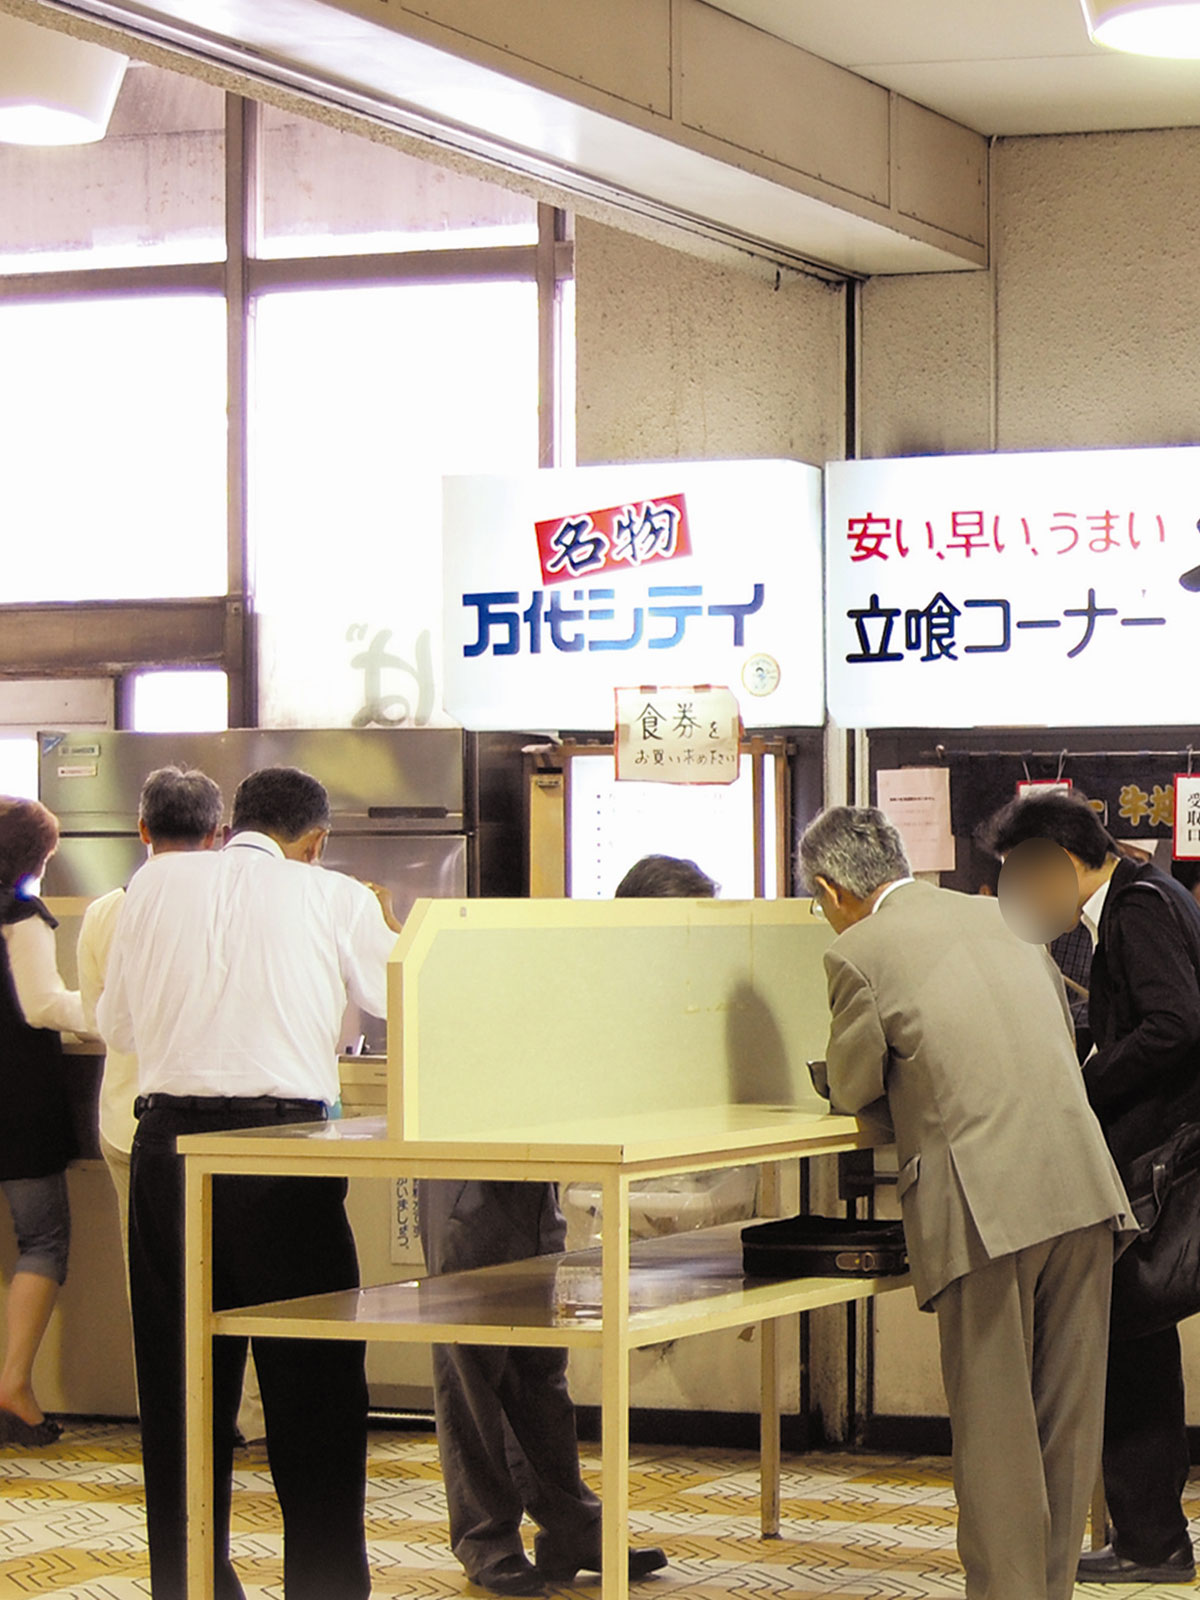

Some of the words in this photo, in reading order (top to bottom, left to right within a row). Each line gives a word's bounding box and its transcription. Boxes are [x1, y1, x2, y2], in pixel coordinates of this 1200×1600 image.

[546, 500, 681, 577] 名物
[846, 588, 1166, 663] 立喰コーナー
[636, 702, 721, 741] 食券を
